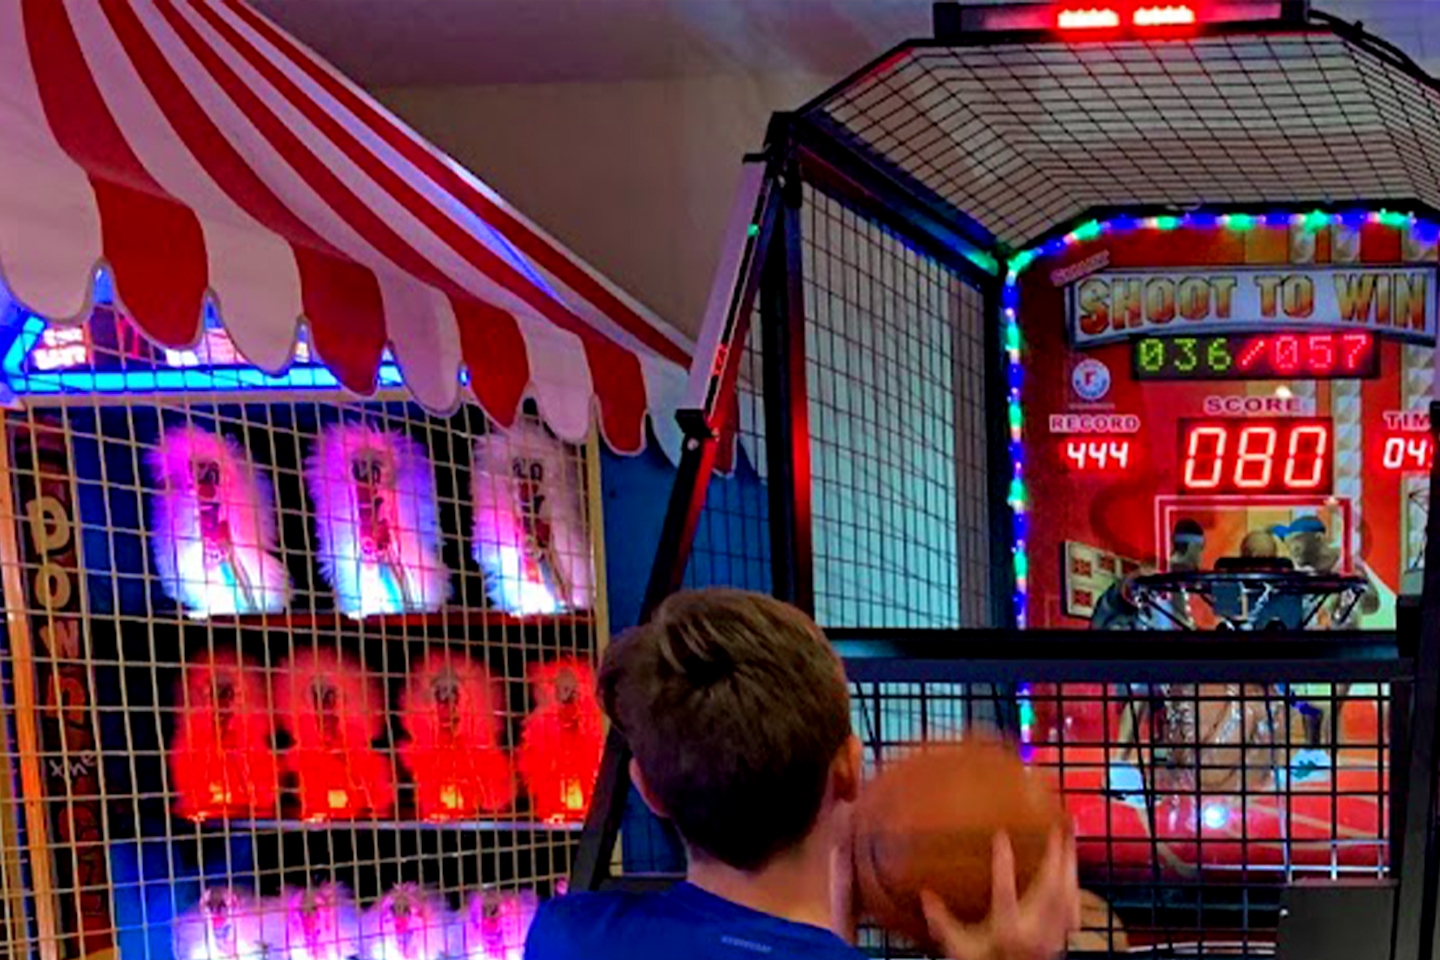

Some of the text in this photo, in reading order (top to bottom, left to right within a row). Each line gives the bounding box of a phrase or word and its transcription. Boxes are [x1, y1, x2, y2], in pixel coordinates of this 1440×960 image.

[1078, 272, 1427, 335] SHOOT TO WIN
[1203, 396, 1302, 415] SCORE
[1049, 414, 1141, 433] RECORD
[1383, 411, 1431, 432] TIM
[1066, 441, 1130, 469] 444
[1183, 426, 1328, 488] 080
[1383, 437, 1433, 469] 04
